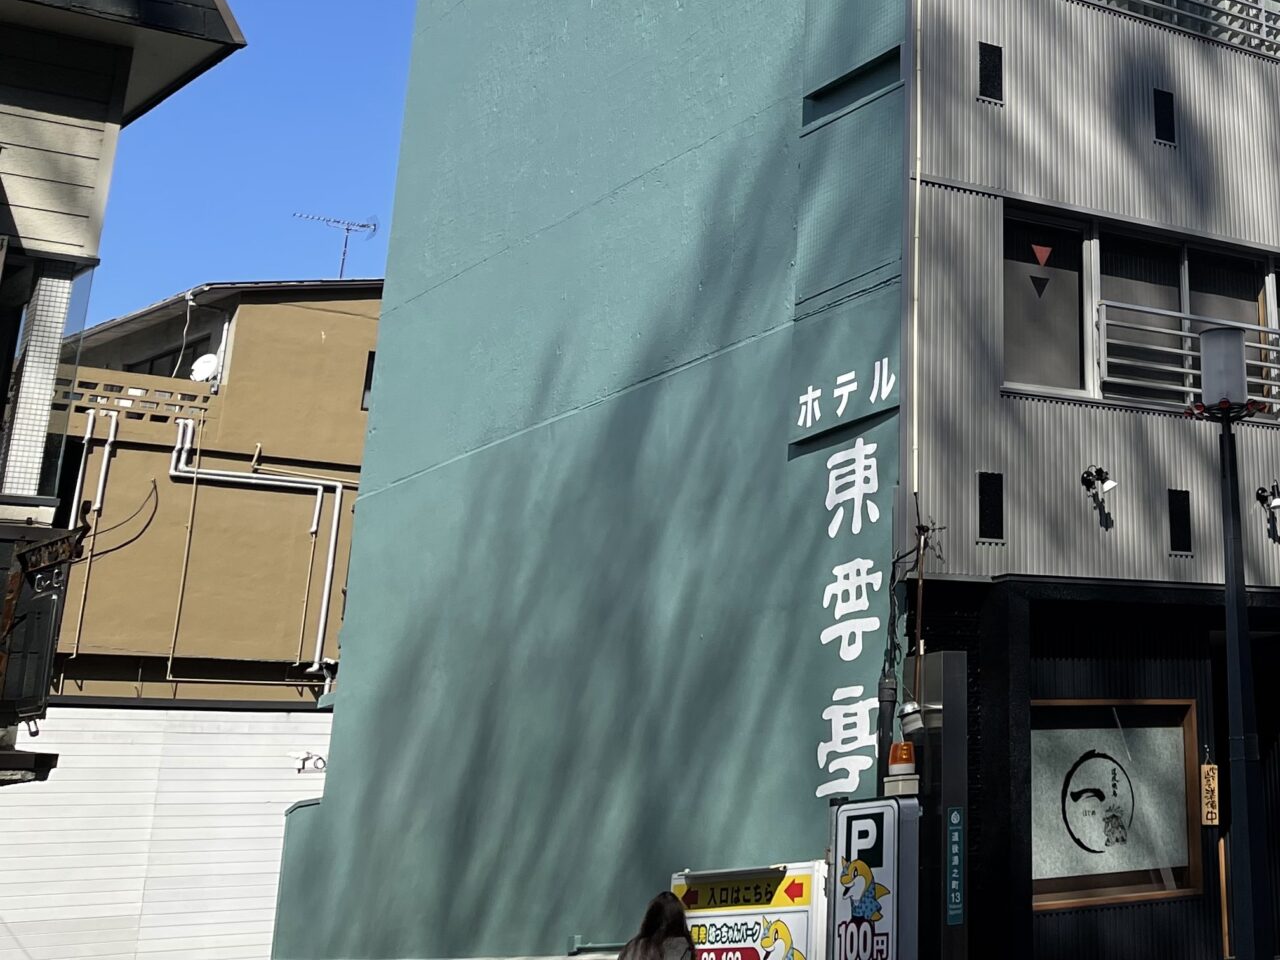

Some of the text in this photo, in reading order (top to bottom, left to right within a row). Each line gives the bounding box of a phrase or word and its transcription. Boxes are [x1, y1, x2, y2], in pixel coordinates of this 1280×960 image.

[797, 357, 895, 429] ホテル
[815, 437, 882, 798] 東雲亭
[851, 819, 877, 861] P
[707, 882, 773, 906] 入口はこちら
[838, 921, 888, 960] 100円
